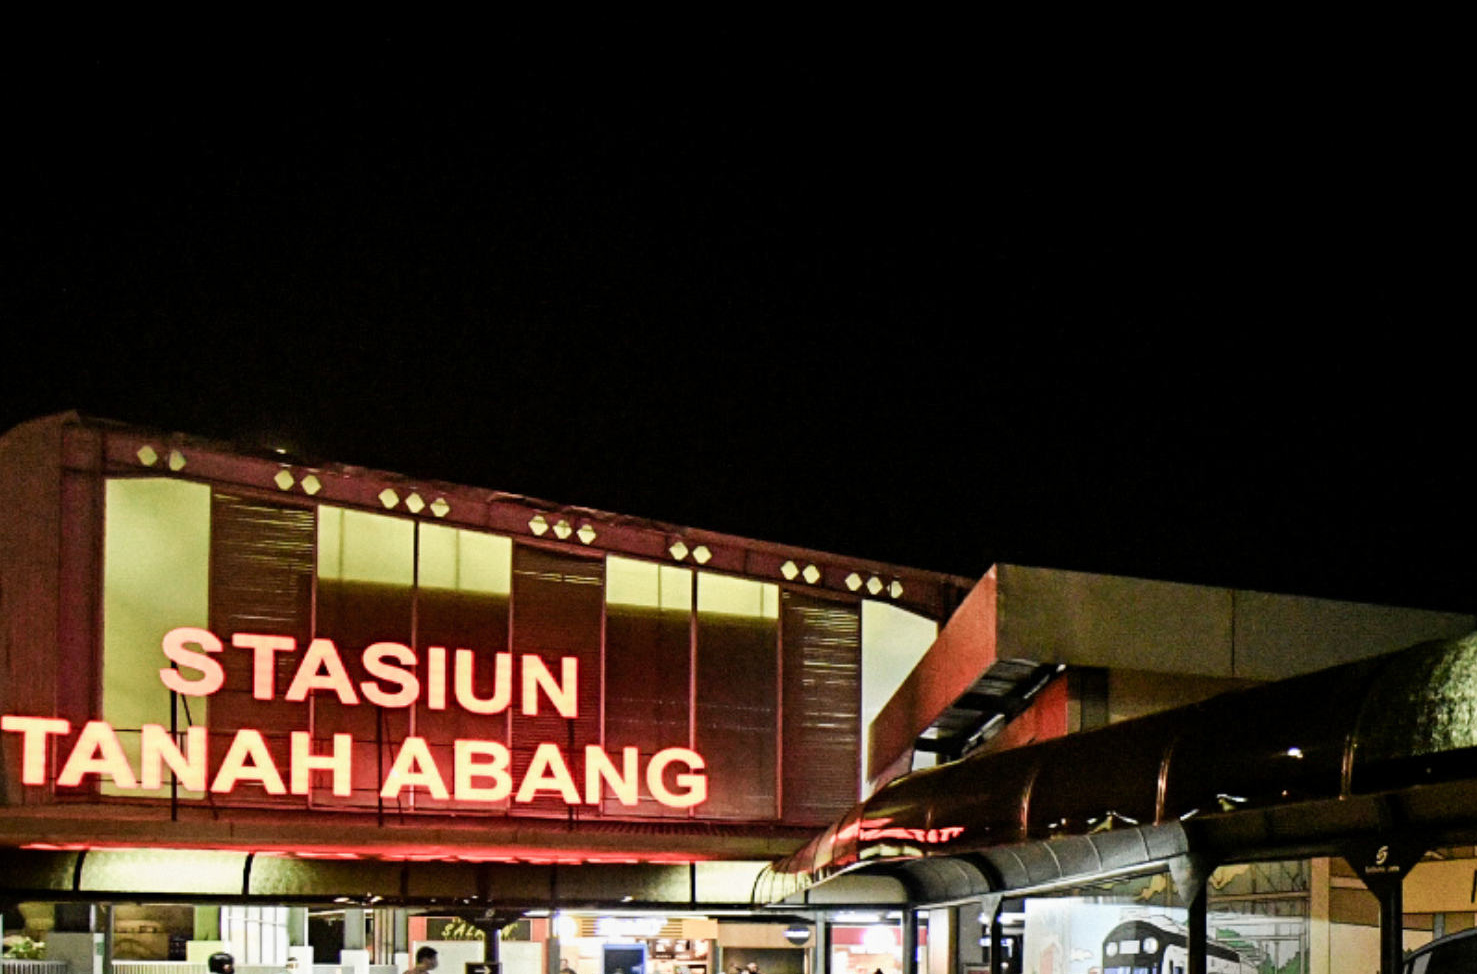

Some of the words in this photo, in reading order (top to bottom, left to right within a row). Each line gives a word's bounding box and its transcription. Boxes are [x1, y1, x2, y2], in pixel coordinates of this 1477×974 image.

[159, 627, 578, 719] STASIUN
[1, 715, 352, 797] TANAH
[380, 736, 707, 809] ABANG
